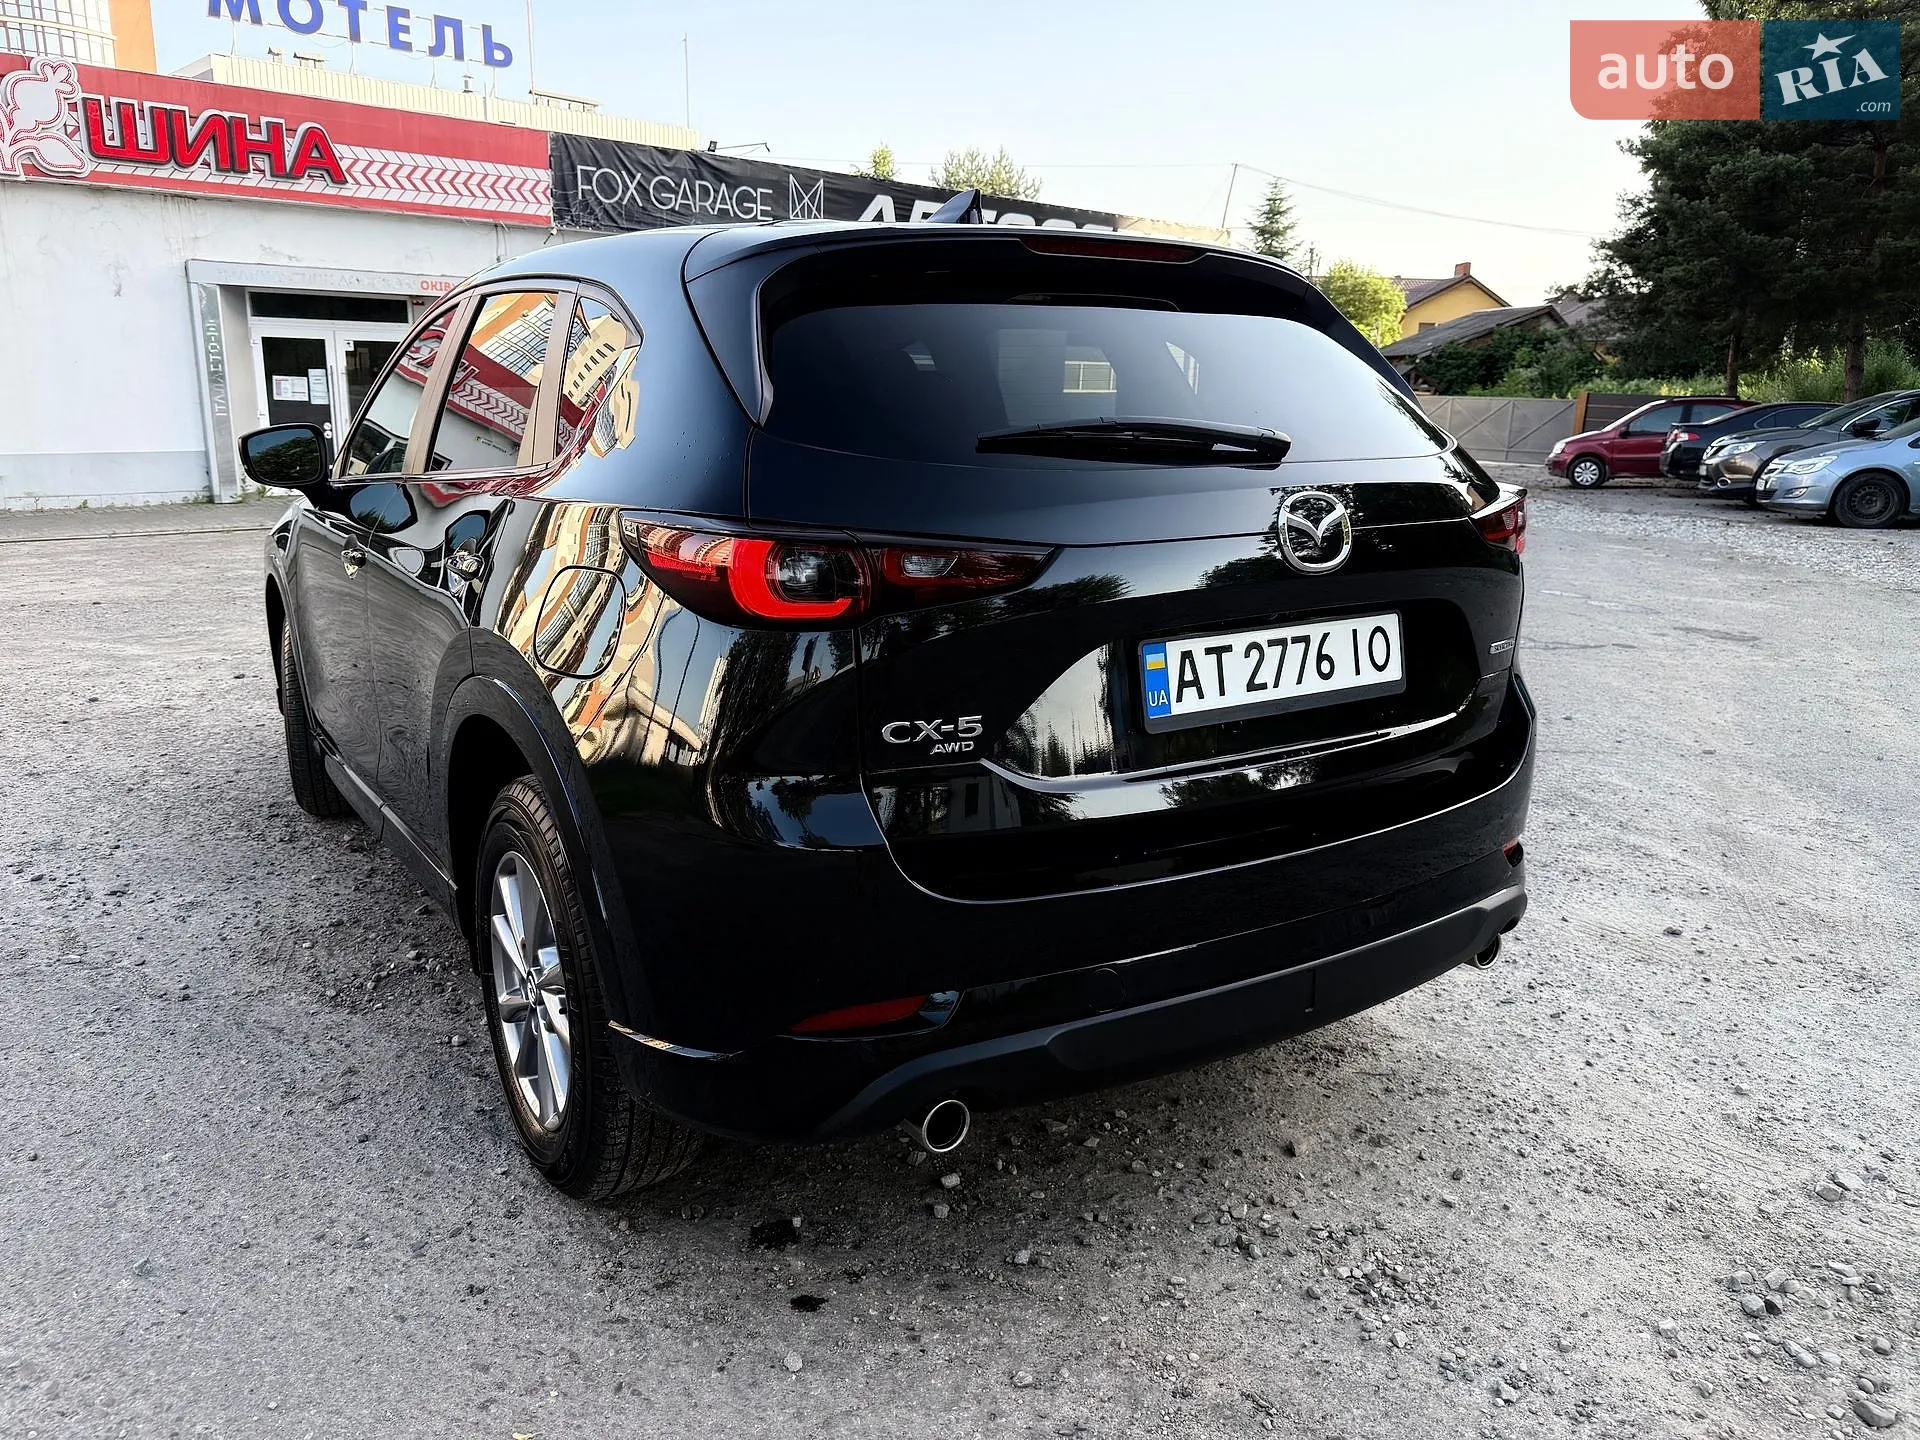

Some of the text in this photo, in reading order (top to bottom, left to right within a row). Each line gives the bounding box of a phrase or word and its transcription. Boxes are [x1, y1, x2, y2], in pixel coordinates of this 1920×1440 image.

[80, 95, 352, 186] ШИНА
[577, 165, 773, 221] FOX GARAGE
[1175, 625, 1391, 704] AT 2776 IO
[1149, 689, 1169, 707] UA
[881, 715, 984, 744] CX-5
[929, 741, 975, 755] AWD
